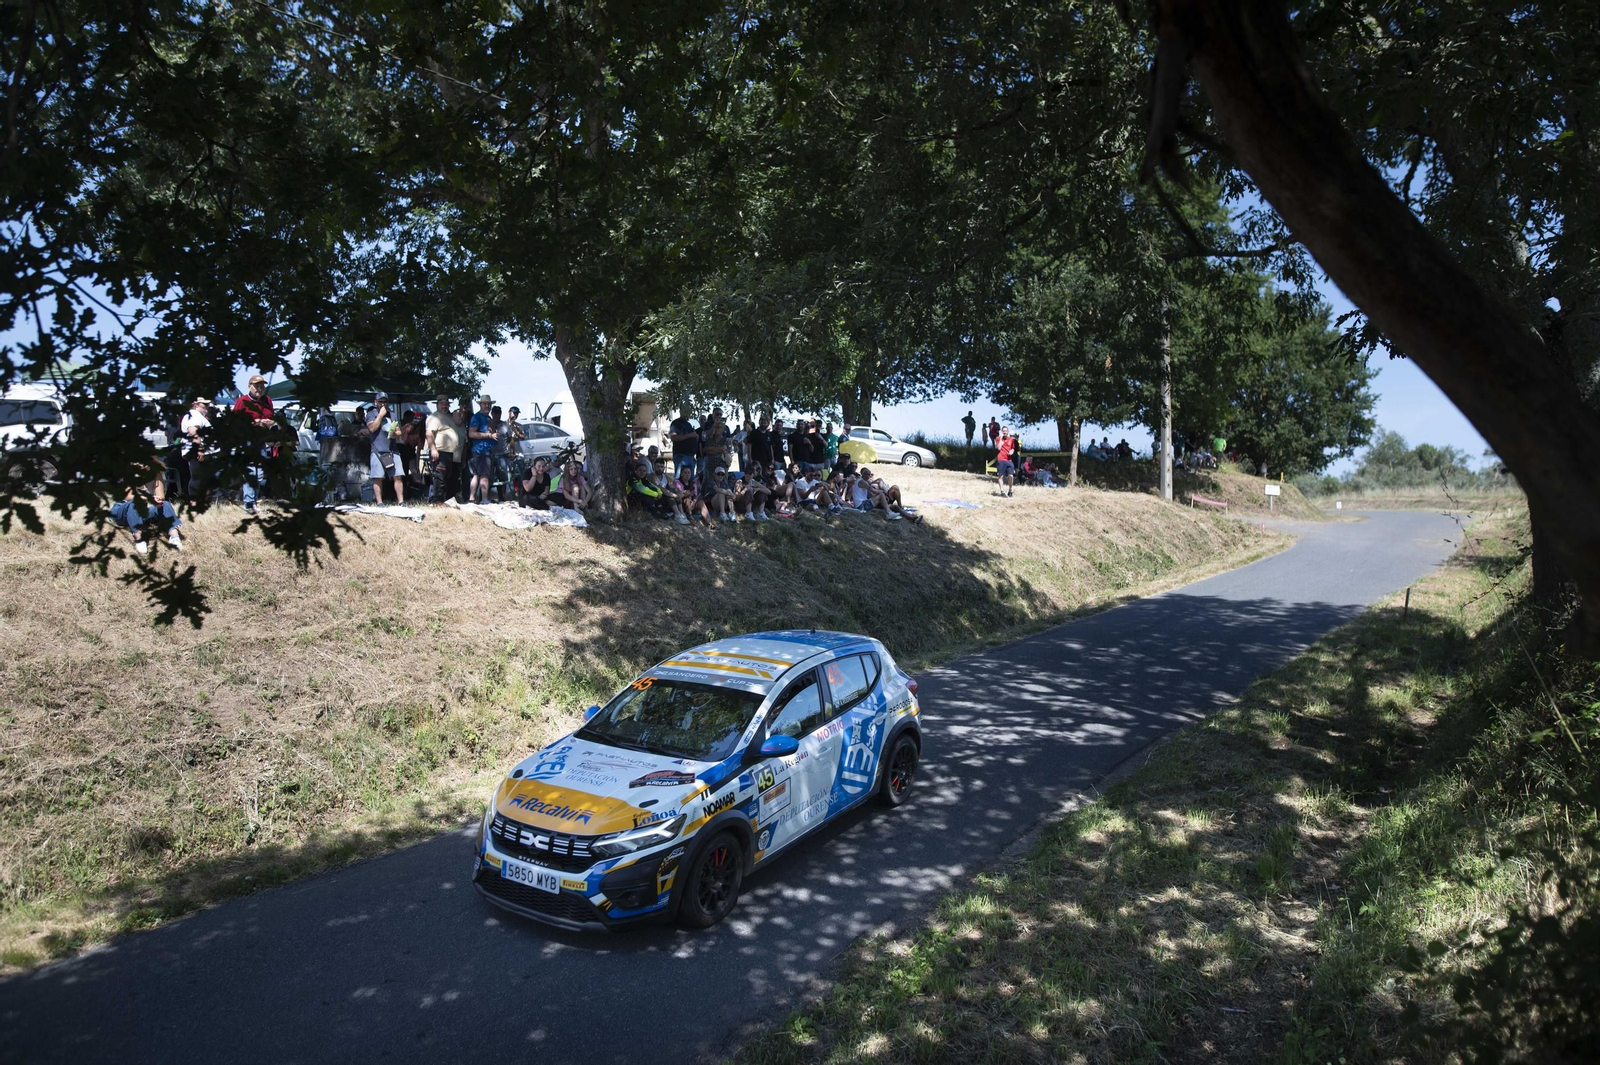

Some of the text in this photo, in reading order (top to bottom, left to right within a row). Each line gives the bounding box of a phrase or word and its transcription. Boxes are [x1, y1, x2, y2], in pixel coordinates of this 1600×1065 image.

[631, 676, 658, 691] 45
[668, 670, 709, 680] SANDERO
[827, 663, 844, 687] 45
[816, 719, 844, 743] MOTRIO
[565, 774, 606, 788] OURENSE
[758, 767, 774, 790] 45
[519, 797, 583, 821] Recalvi
[702, 791, 736, 818] NOAMAR
[803, 791, 839, 822] OURENSE
[508, 863, 557, 891] 5850 MYB
